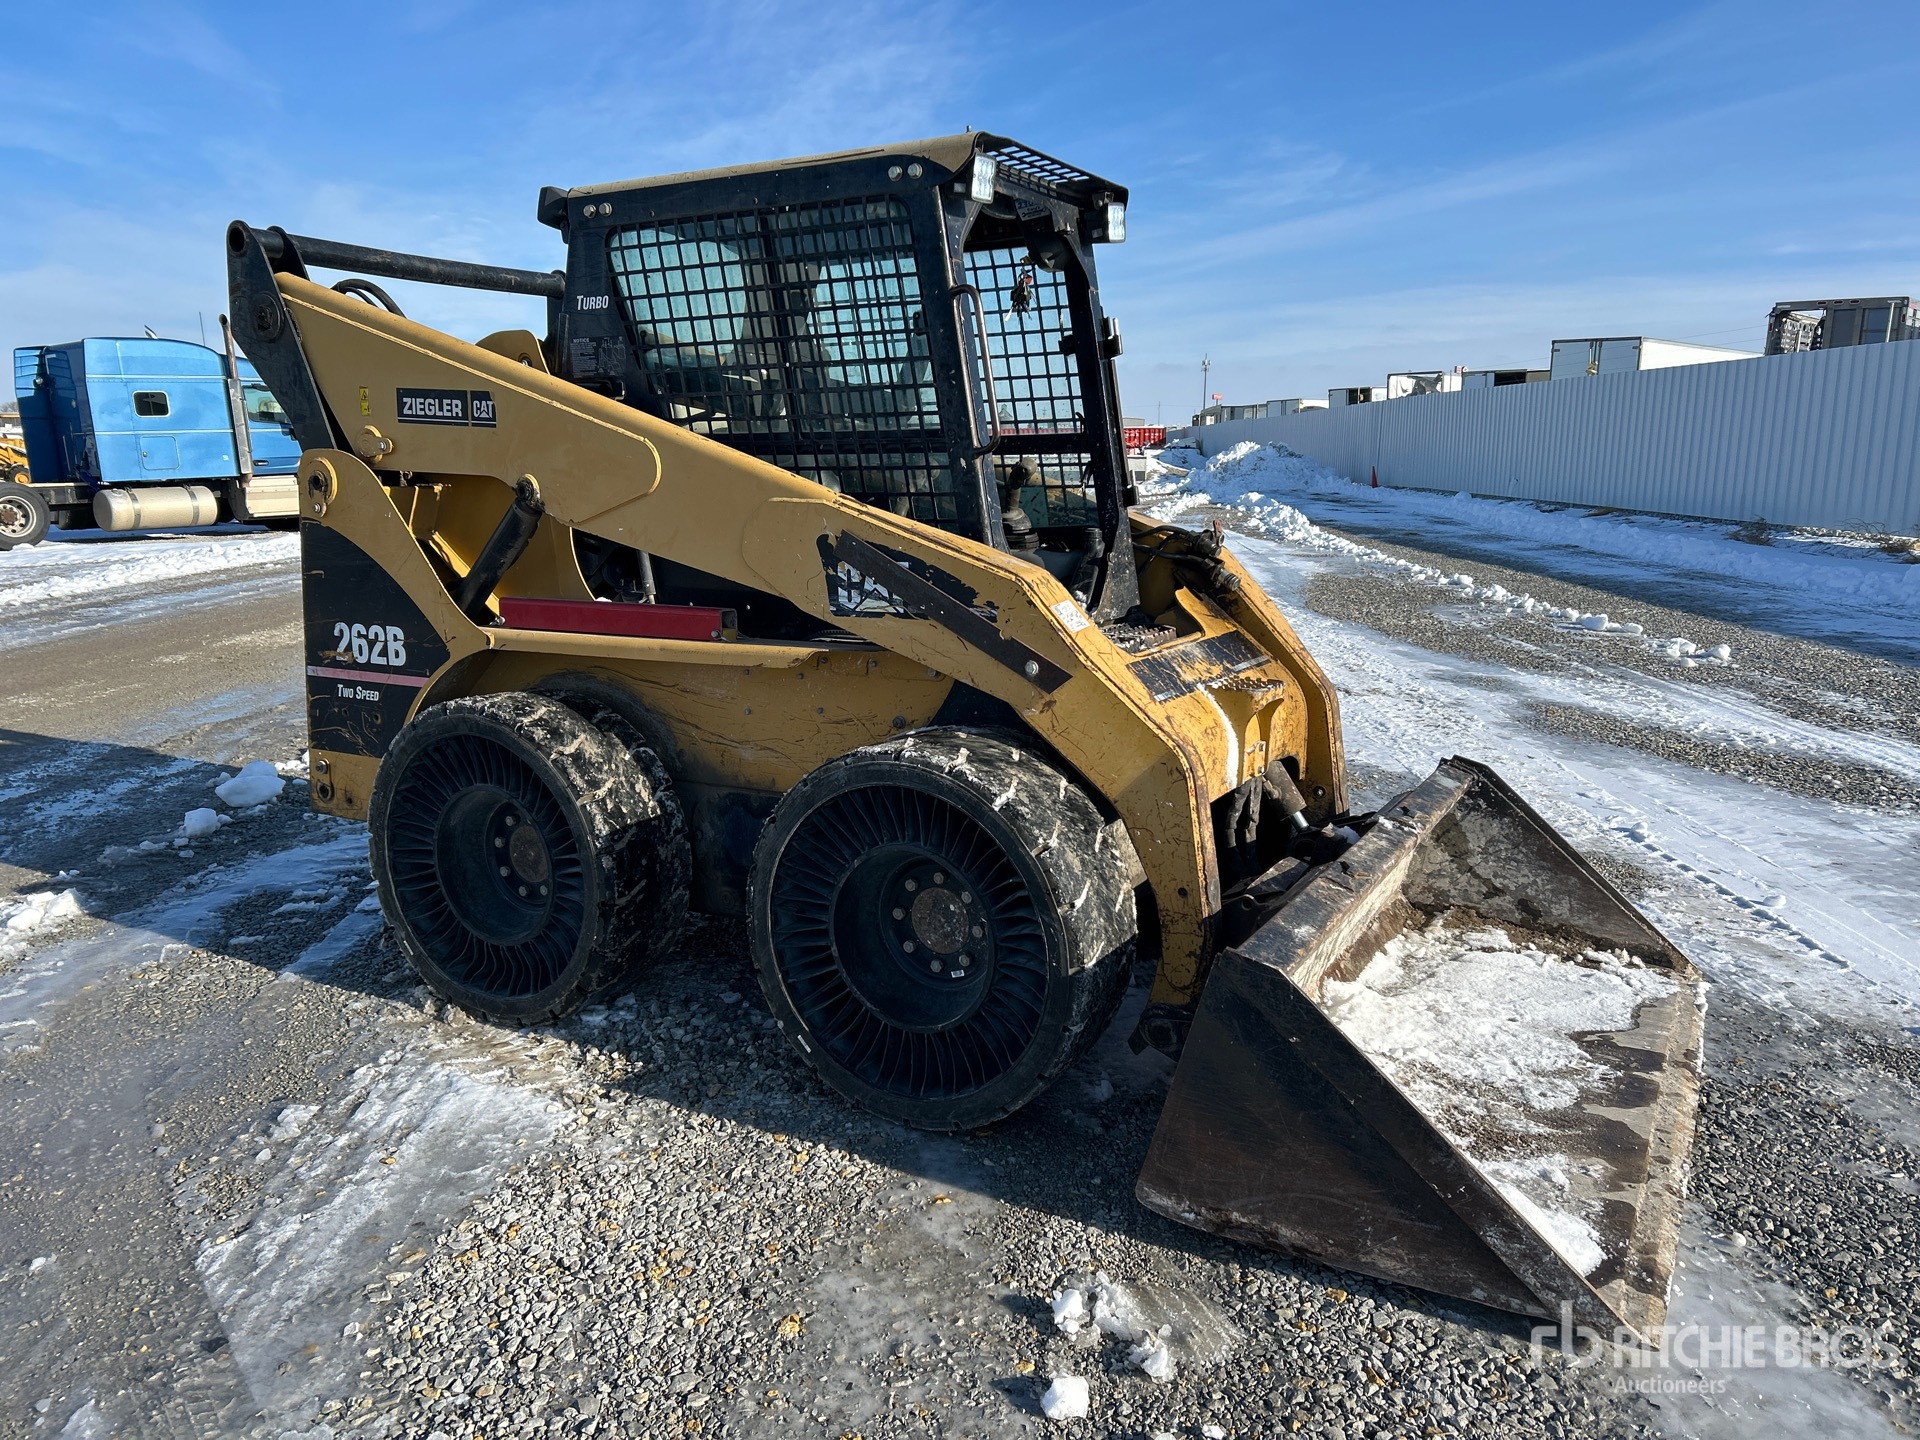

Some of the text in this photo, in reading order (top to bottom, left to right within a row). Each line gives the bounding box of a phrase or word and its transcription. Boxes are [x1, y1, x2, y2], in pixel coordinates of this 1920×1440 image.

[402, 397, 493, 418] ZIEGLER CAT
[333, 622, 407, 667] 262B
